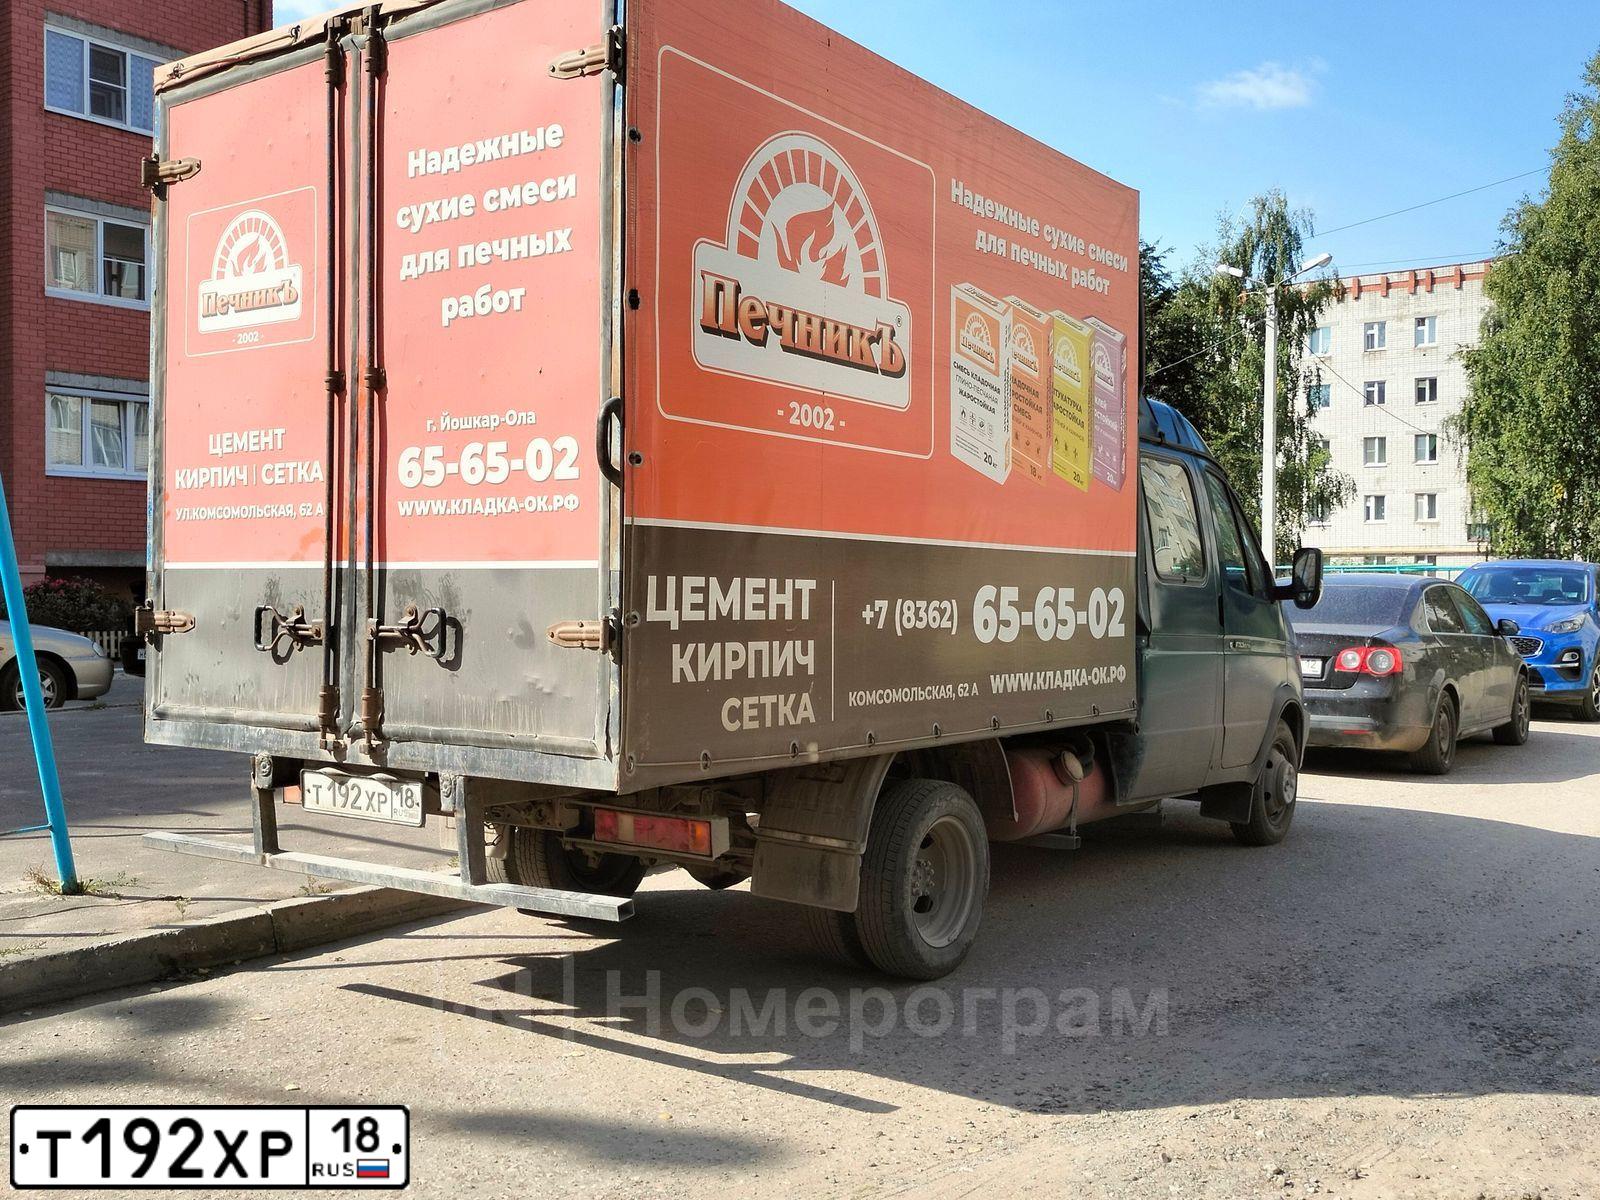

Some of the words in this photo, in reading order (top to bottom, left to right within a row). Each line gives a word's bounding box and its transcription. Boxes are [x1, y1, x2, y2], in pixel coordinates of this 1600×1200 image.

[407, 123, 564, 178] Надежные
[396, 193, 476, 234] сухие
[483, 174, 577, 213] смеси
[951, 178, 1040, 237] Надежные
[1043, 224, 1086, 256] сухие
[1088, 243, 1128, 272] смеси
[399, 248, 450, 281] для
[457, 227, 573, 268] печных
[975, 229, 1007, 257] для
[1010, 242, 1068, 281] печных
[1071, 266, 1110, 296] работ
[441, 283, 526, 327] работ
[952, 361, 970, 376] СМЕСЬ
[970, 371, 1001, 395] КЛАДОЧНАЯ
[958, 387, 996, 415] ЖАРОСТОЙКАЯ
[1013, 403, 1032, 420] СМЕСЬ
[1053, 402, 1085, 430] АРОСТОЙКАЯ
[426, 419, 437, 432] г.
[440, 409, 536, 431] Йошкар-Ола
[208, 428, 286, 457] ЦЕМЕНТ
[397, 435, 580, 488] 65-65-02
[983, 452, 993, 467] 20
[175, 464, 248, 490] КИРПИЧ
[261, 460, 324, 485] СЕТКА
[1073, 472, 1081, 484] 20
[175, 504, 296, 521] УЛ.КОМСОМОЛЬСКАЯ,
[299, 502, 313, 517] 62
[316, 504, 324, 516] А
[397, 493, 580, 517] WWW.КЛАДКА-ОК.РФ
[646, 575, 817, 630] ЦЕМЕНТ
[861, 600, 888, 628] +7
[895, 599, 959, 637] (8362)
[972, 584, 1126, 644] 65-65-02
[671, 640, 815, 684] КИРПИЧ
[848, 684, 957, 708] КОМСОМОЛЬСКАЯ,
[957, 683, 970, 698] 62
[971, 682, 979, 697] А
[990, 665, 1127, 695] WWW.КЛАДКА-ОК.РФ
[721, 692, 816, 732] СЕТКА
[396, 785, 415, 809] 18
